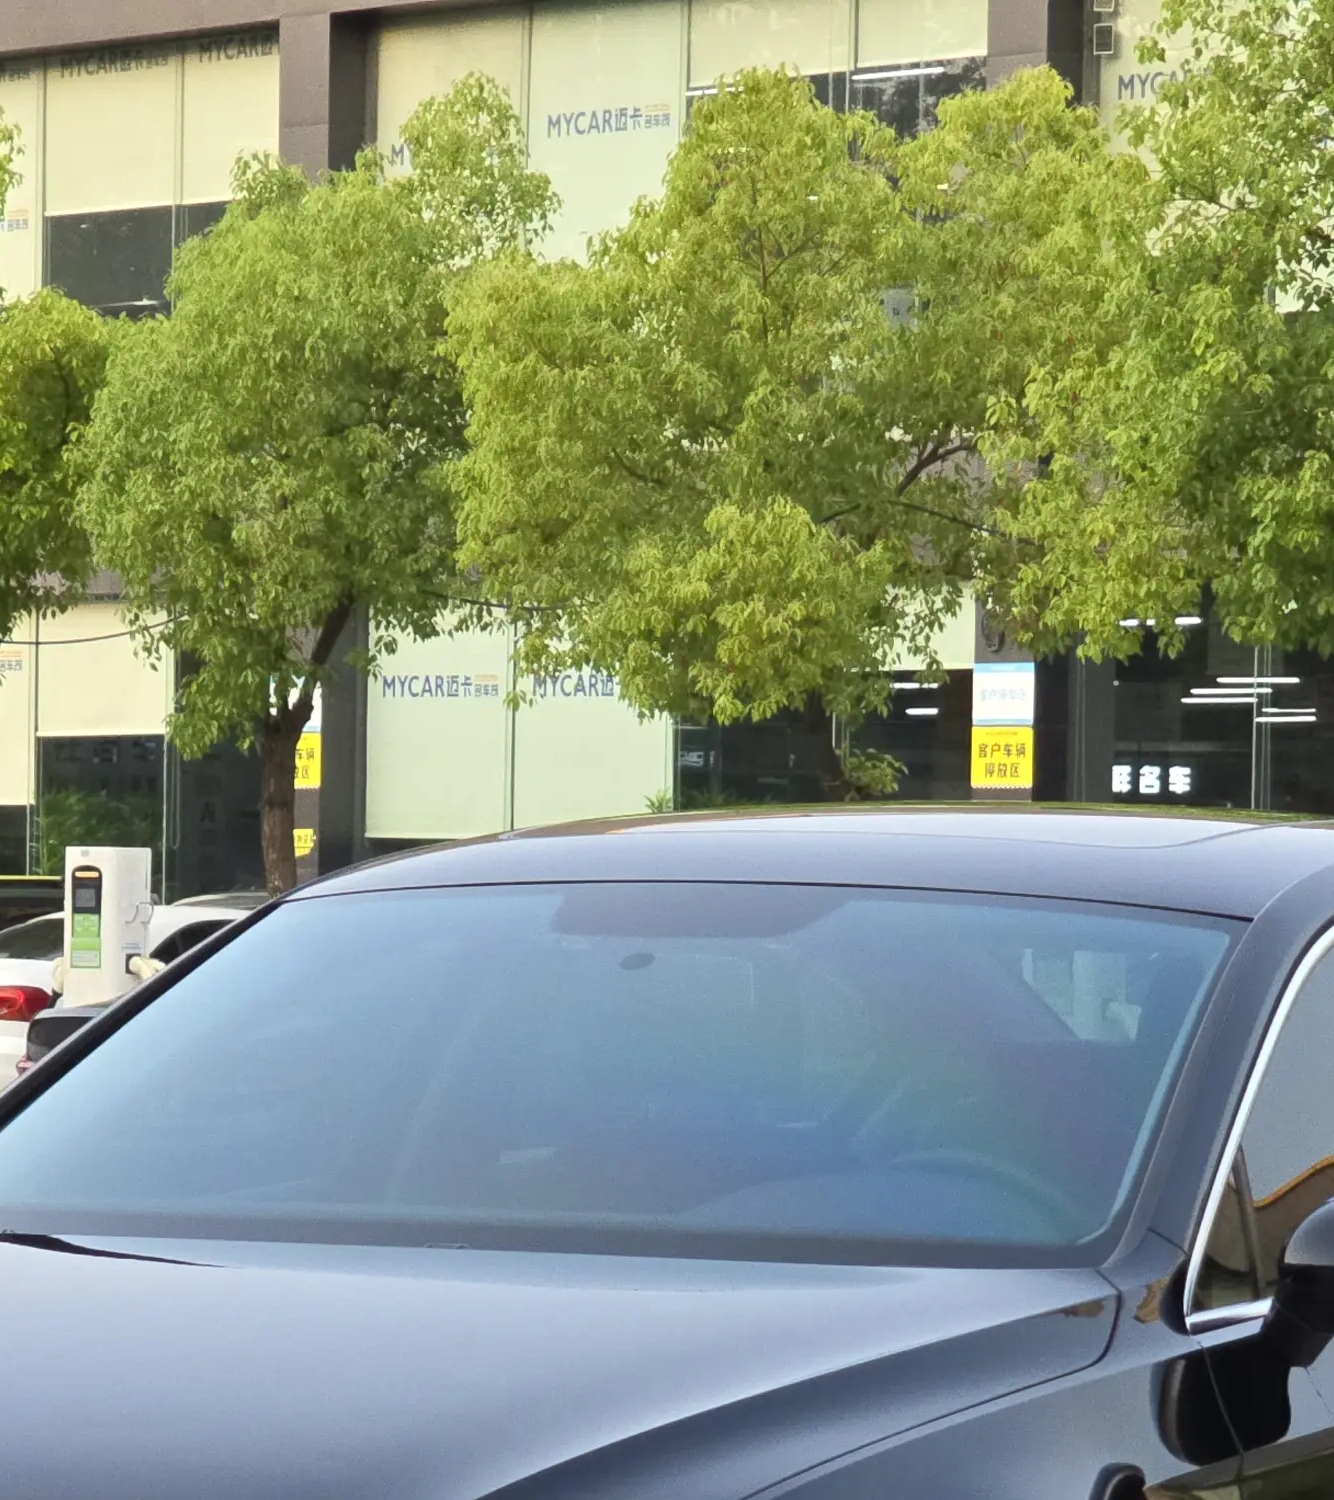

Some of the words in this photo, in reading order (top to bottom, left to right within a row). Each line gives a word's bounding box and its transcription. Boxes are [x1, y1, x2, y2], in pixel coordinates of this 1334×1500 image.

[978, 743, 1026, 759] 客户车辆
[984, 762, 1020, 778] 停放区
